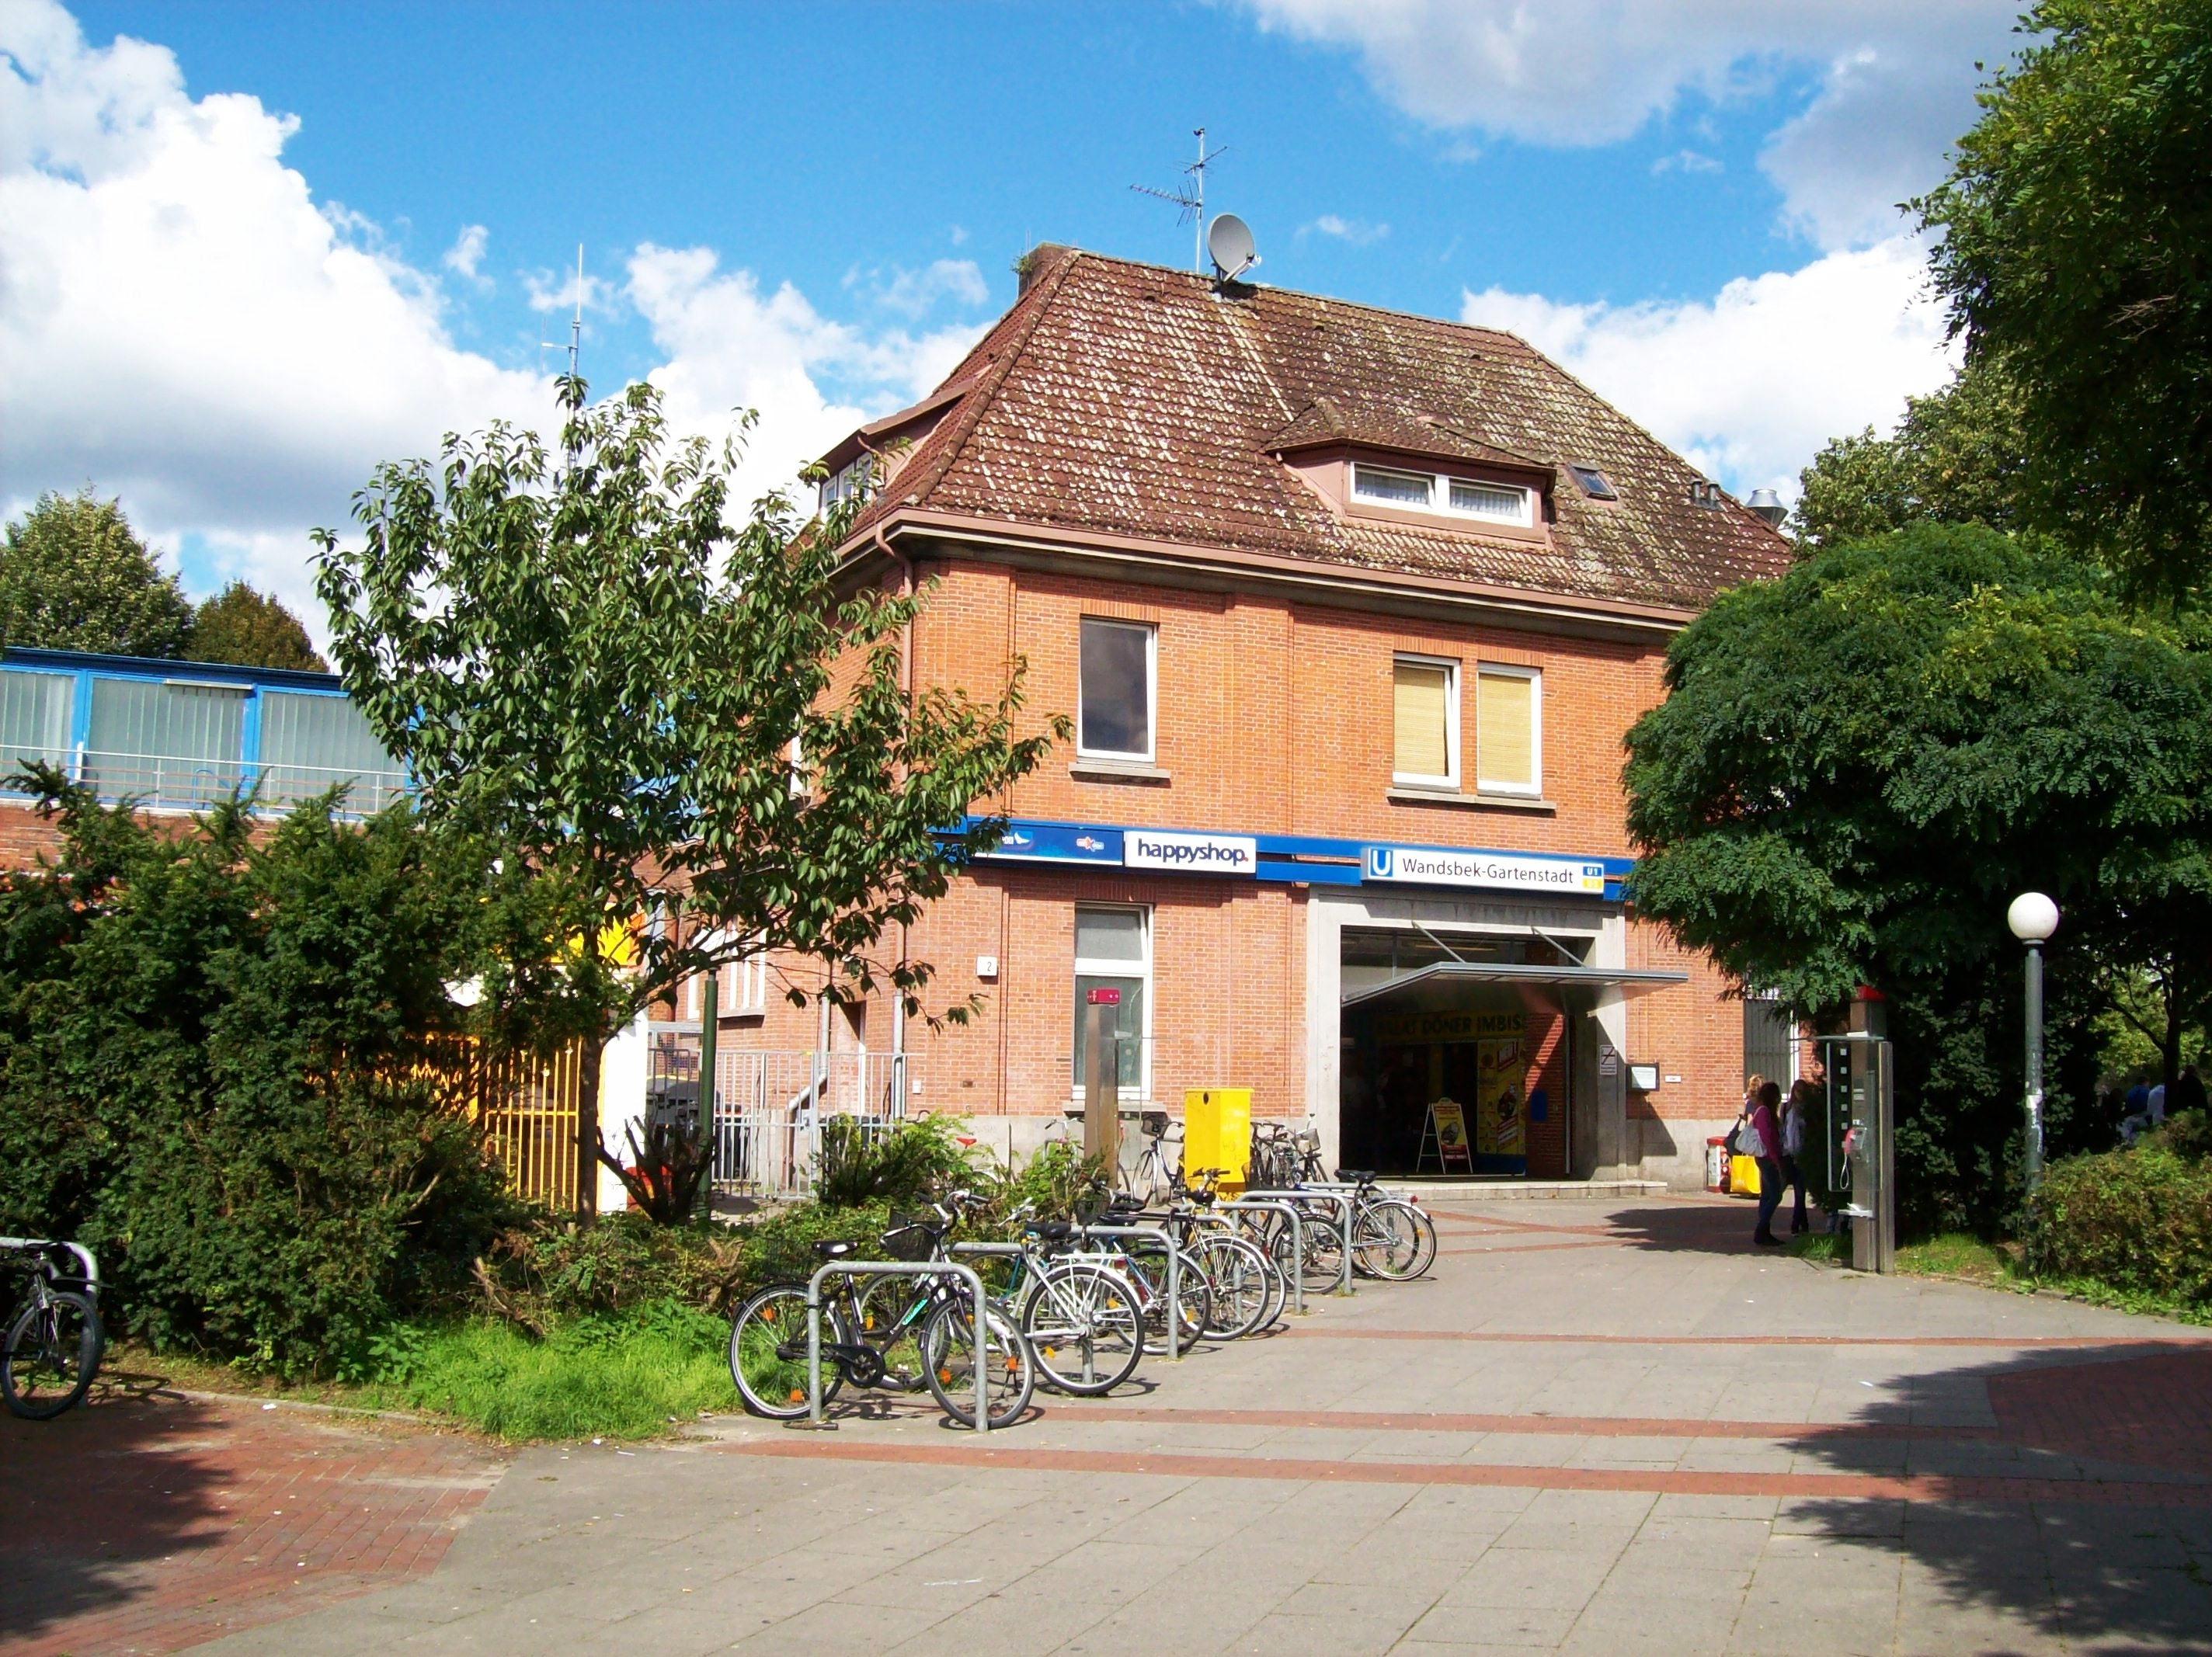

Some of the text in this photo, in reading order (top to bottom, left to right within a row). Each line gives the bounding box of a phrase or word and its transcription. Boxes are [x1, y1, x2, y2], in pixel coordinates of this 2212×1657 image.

[1372, 849, 1574, 884] U Wandsbek-Gartenstadt
[1587, 867, 1598, 876] U1
[987, 961, 992, 972] 2
[1421, 1015, 1471, 1034] DÖNER
